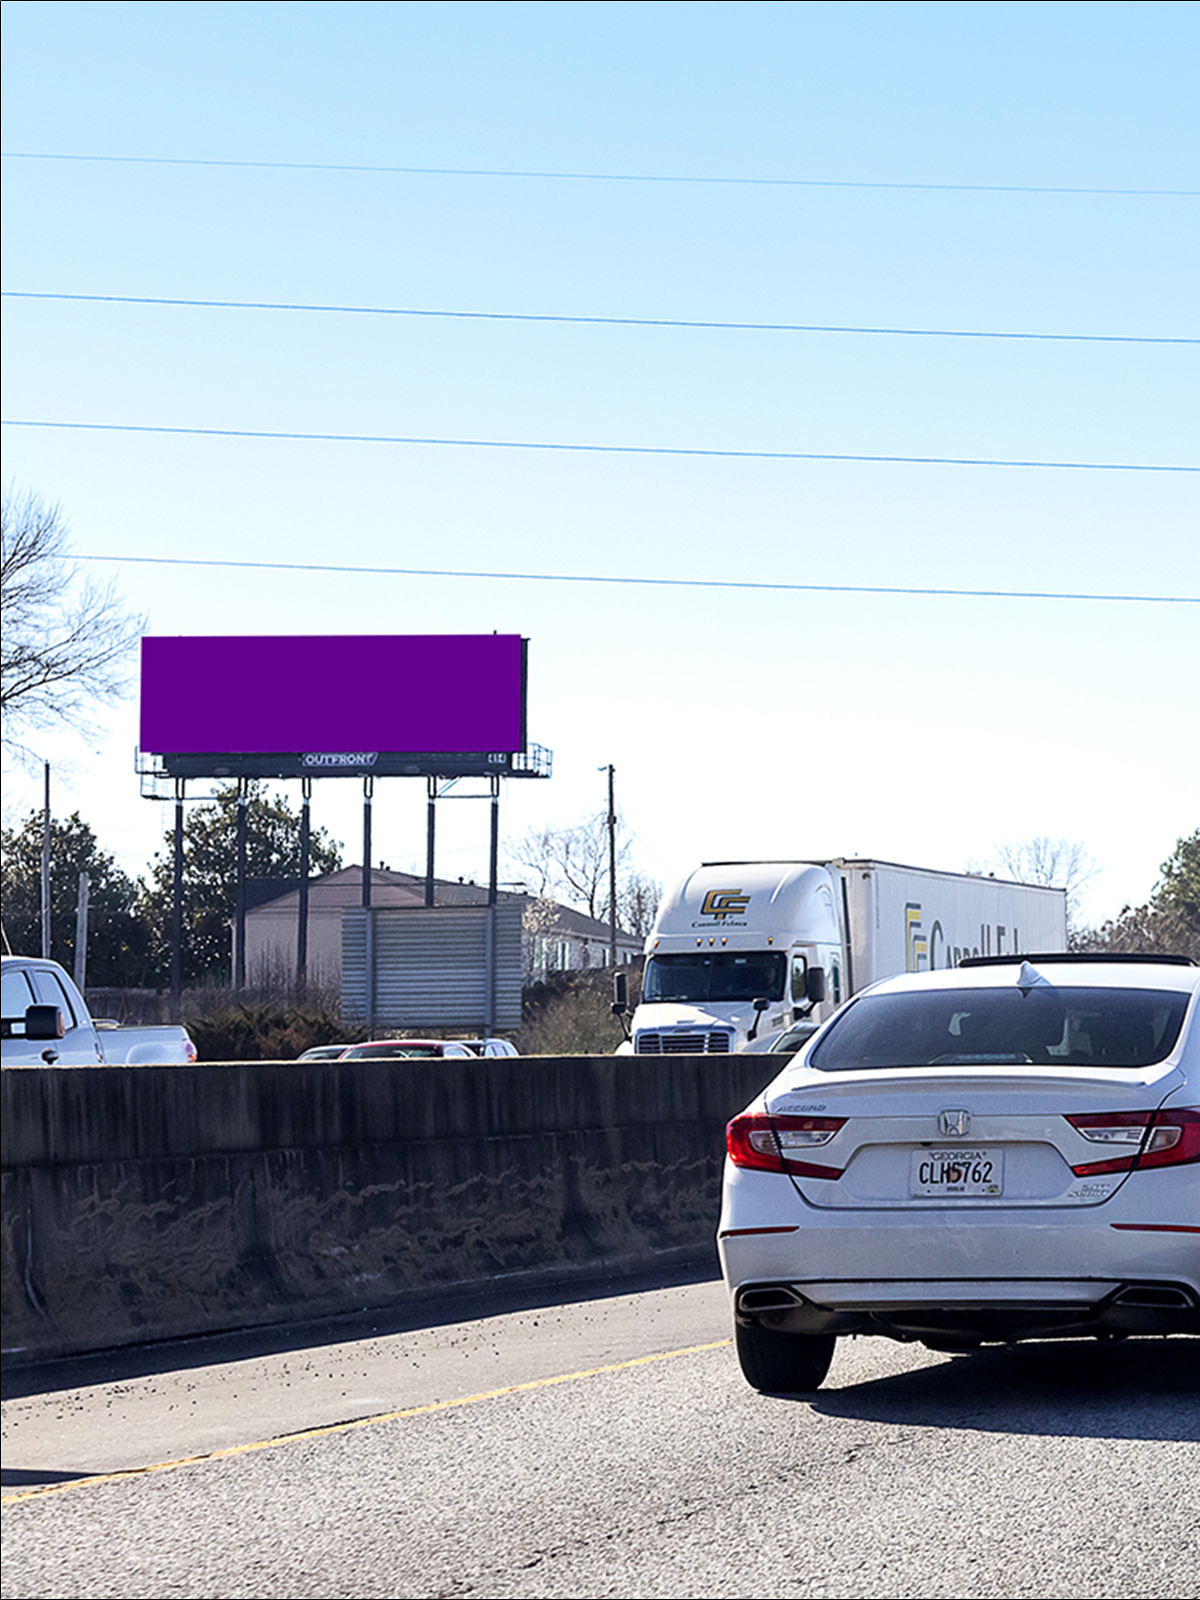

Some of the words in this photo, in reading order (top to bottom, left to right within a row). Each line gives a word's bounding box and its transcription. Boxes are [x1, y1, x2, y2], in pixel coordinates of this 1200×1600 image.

[305, 754, 374, 765] OUTFRONT
[932, 1151, 982, 1161] GEORGIA
[919, 1161, 993, 1184] CLH5762
